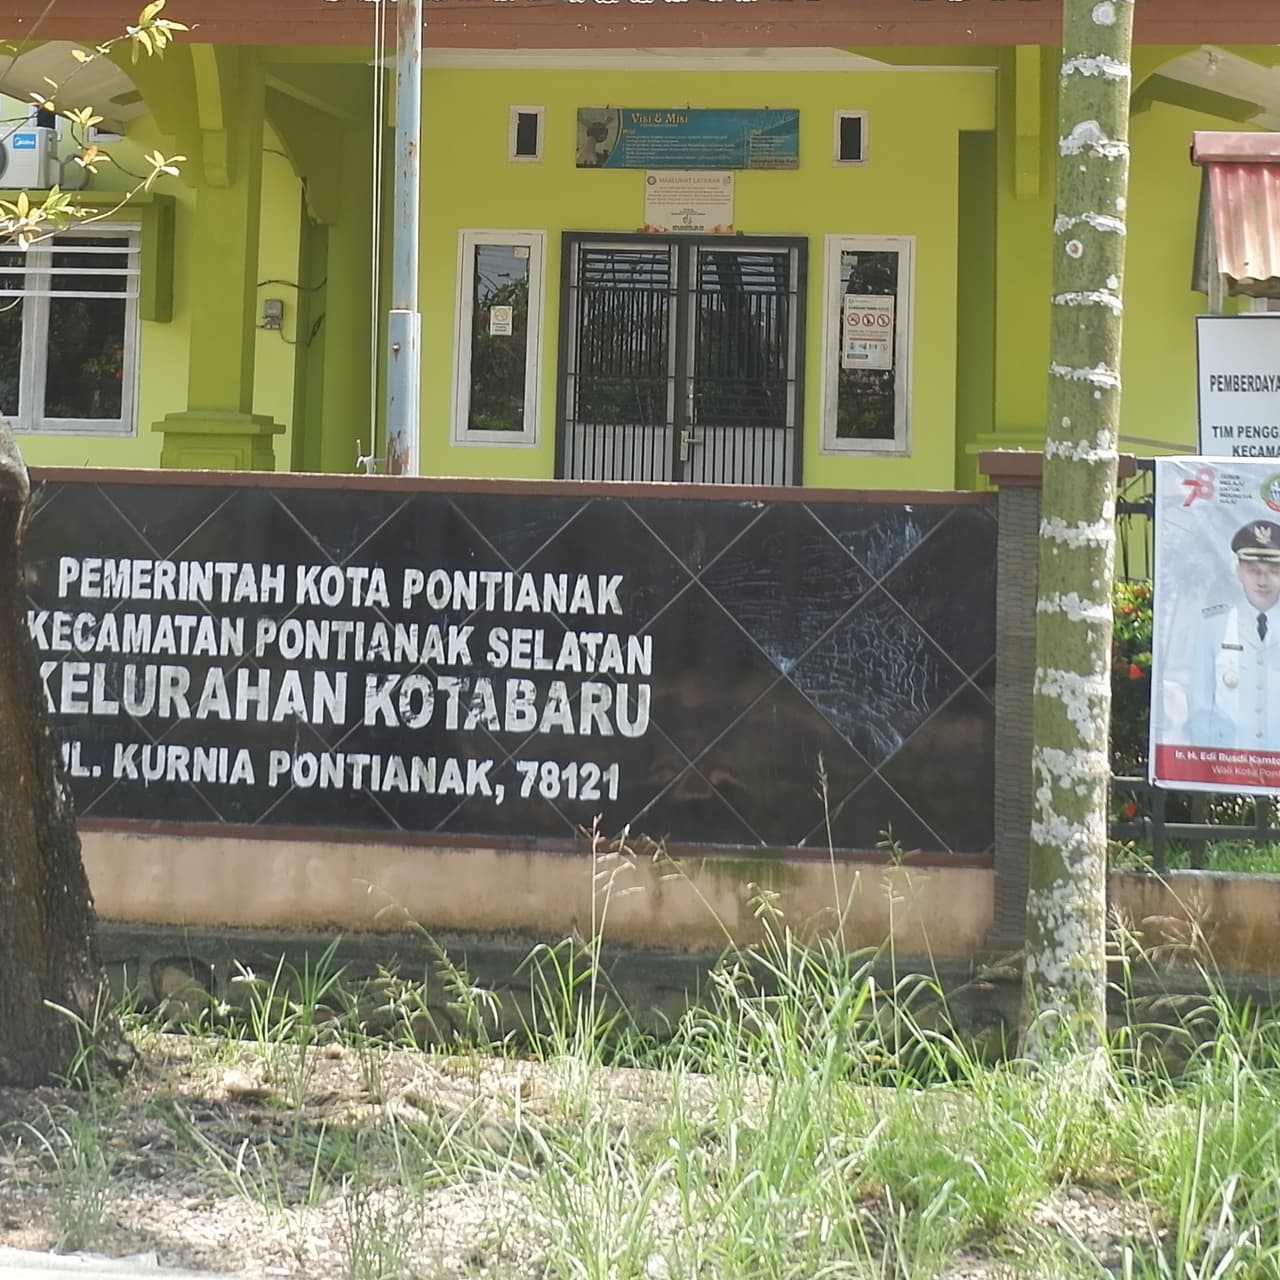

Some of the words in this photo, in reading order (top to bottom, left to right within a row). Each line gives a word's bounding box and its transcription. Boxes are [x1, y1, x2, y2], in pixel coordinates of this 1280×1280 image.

[1212, 426, 1234, 438] TIM
[58, 556, 285, 604] PEMERINTAH
[296, 565, 390, 607] KOTA
[402, 568, 623, 615] PONTIANAK
[27, 610, 244, 656] KECAMATAN
[255, 618, 474, 666] PONTIANAK
[486, 627, 652, 676] SELATAN
[39, 661, 347, 725] KELURAHAN
[363, 672, 651, 738] KOTABARU
[113, 742, 255, 784] KURNIA
[269, 750, 505, 806] PONTIANAK,
[516, 760, 619, 801] 78121
[1187, 751, 1198, 761] H.
[1200, 751, 1216, 762] Edi
[1219, 752, 1247, 763] Rusdi
[1211, 764, 1233, 775] Wali
[1235, 765, 1258, 777] Kota
